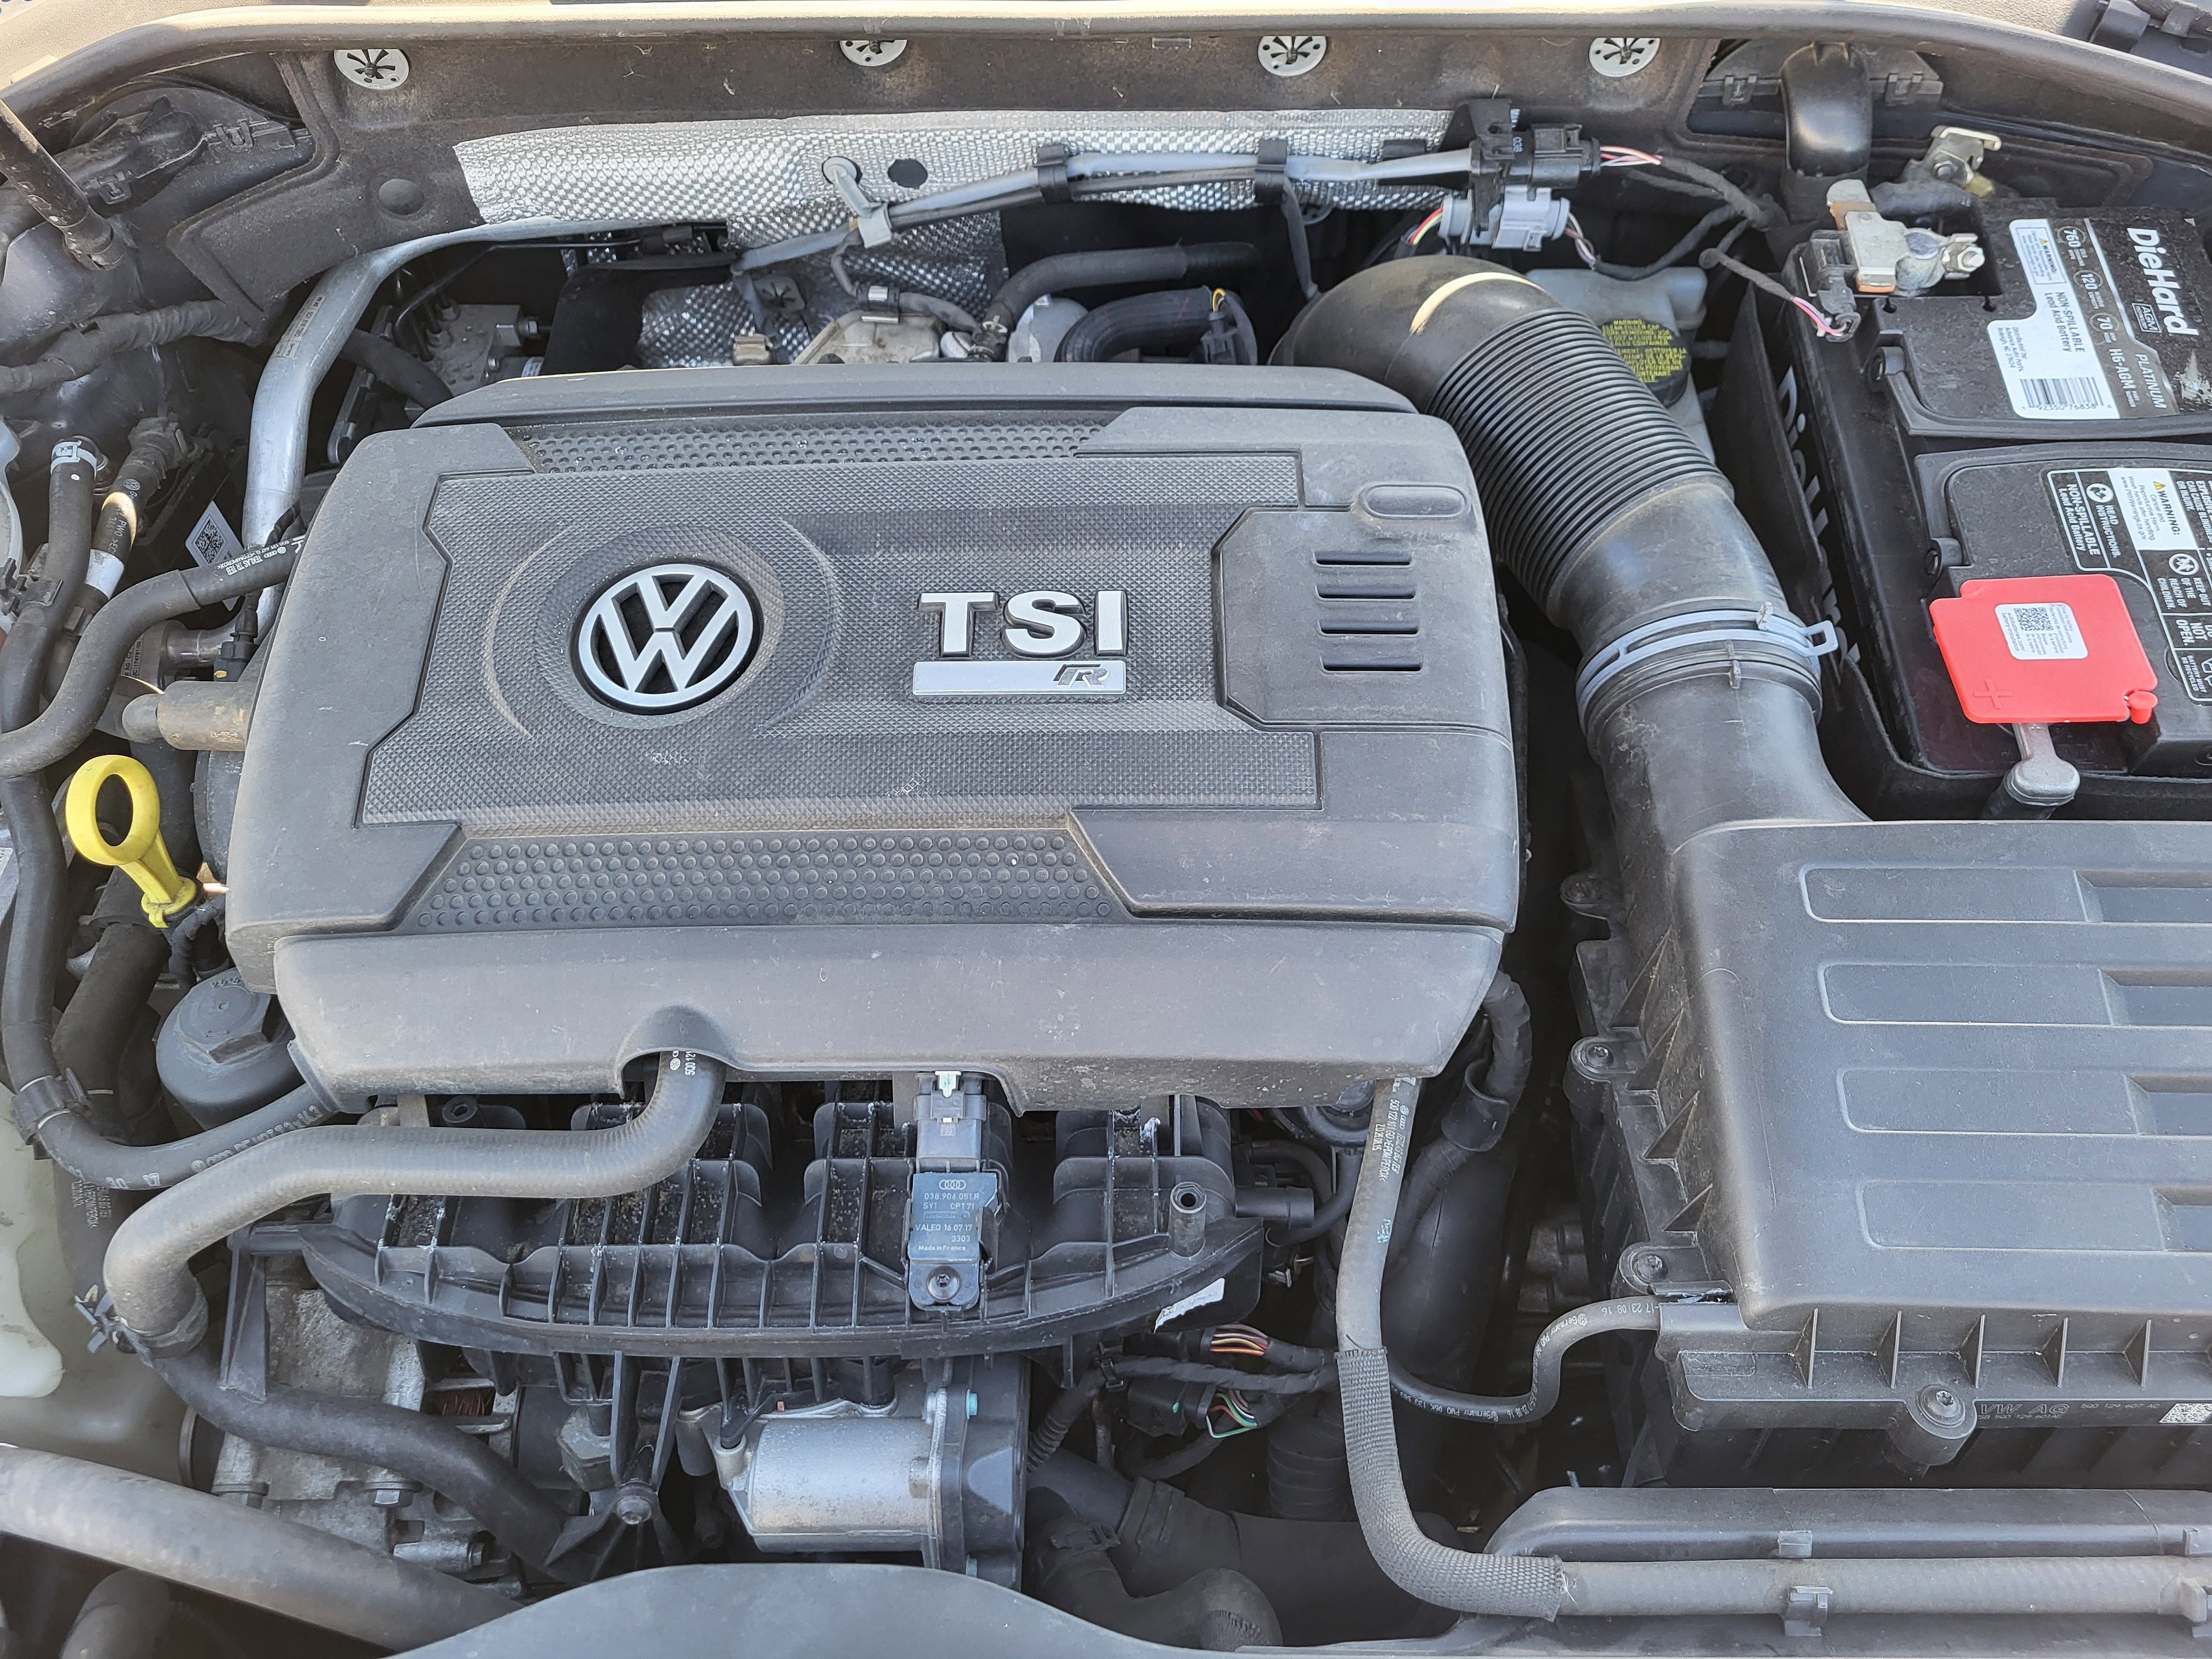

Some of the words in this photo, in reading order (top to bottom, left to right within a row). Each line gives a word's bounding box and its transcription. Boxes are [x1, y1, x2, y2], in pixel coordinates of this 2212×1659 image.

[2127, 228, 2199, 336] DieHard
[2064, 229, 2081, 248] 760
[2080, 273, 2099, 290] 120
[2097, 316, 2114, 330] 70
[2109, 348, 2137, 389] H6-AGM
[2141, 306, 2158, 331] AGM
[2044, 293, 2056, 309] Lead
[2051, 310, 2063, 324] Acid
[2057, 325, 2072, 352] Battery
[2055, 292, 2085, 352] NON-SPILLABLE
[2135, 353, 2167, 409] PLATINUM
[2176, 481, 2187, 489] OR
[2186, 481, 2198, 493] CAN
[2058, 488, 2073, 506] Lead
[2180, 490, 2195, 512] INJURY.
[2190, 493, 2206, 512] CAUSE
[2064, 506, 2077, 525] Acid
[2067, 483, 2101, 556] NON-SPILLABLE
[2105, 504, 2119, 525] READ
[2157, 491, 2180, 535] WARNING:
[2070, 524, 2086, 552] Battery
[2096, 504, 2122, 559] INSTRUCTIONS.
[226, 565, 238, 576] TEB
[243, 555, 263, 568] TEKLAS
[2180, 577, 2192, 587] OF
[2193, 577, 2207, 593] KEEP
[2157, 577, 2177, 610] CHILDREN.
[2168, 577, 2183, 598] REACH
[2176, 597, 2188, 608] OF
[2184, 587, 2197, 599] THE
[2199, 593, 2211, 607] OUT
[919, 589, 1130, 658] TSI
[2176, 619, 2196, 646] OPEN.
[2190, 622, 2208, 641] NOT
[578, 563, 754, 709] VW
[2184, 665, 2200, 692] RECYCLED
[2187, 655, 2202, 682] BATTERY
[685, 1062, 696, 1076] 5Q0
[1389, 1099, 1401, 1112] 5Q0
[1387, 1112, 1399, 1120] 122
[923, 1202, 938, 1210] SY1
[1601, 1306, 1613, 1316] 16
[1550, 1315, 1578, 1335] Germany
[1463, 1409, 1491, 1420] Germany
[1980, 1404, 2022, 1414] VW
[2028, 1404, 2070, 1414] AG
